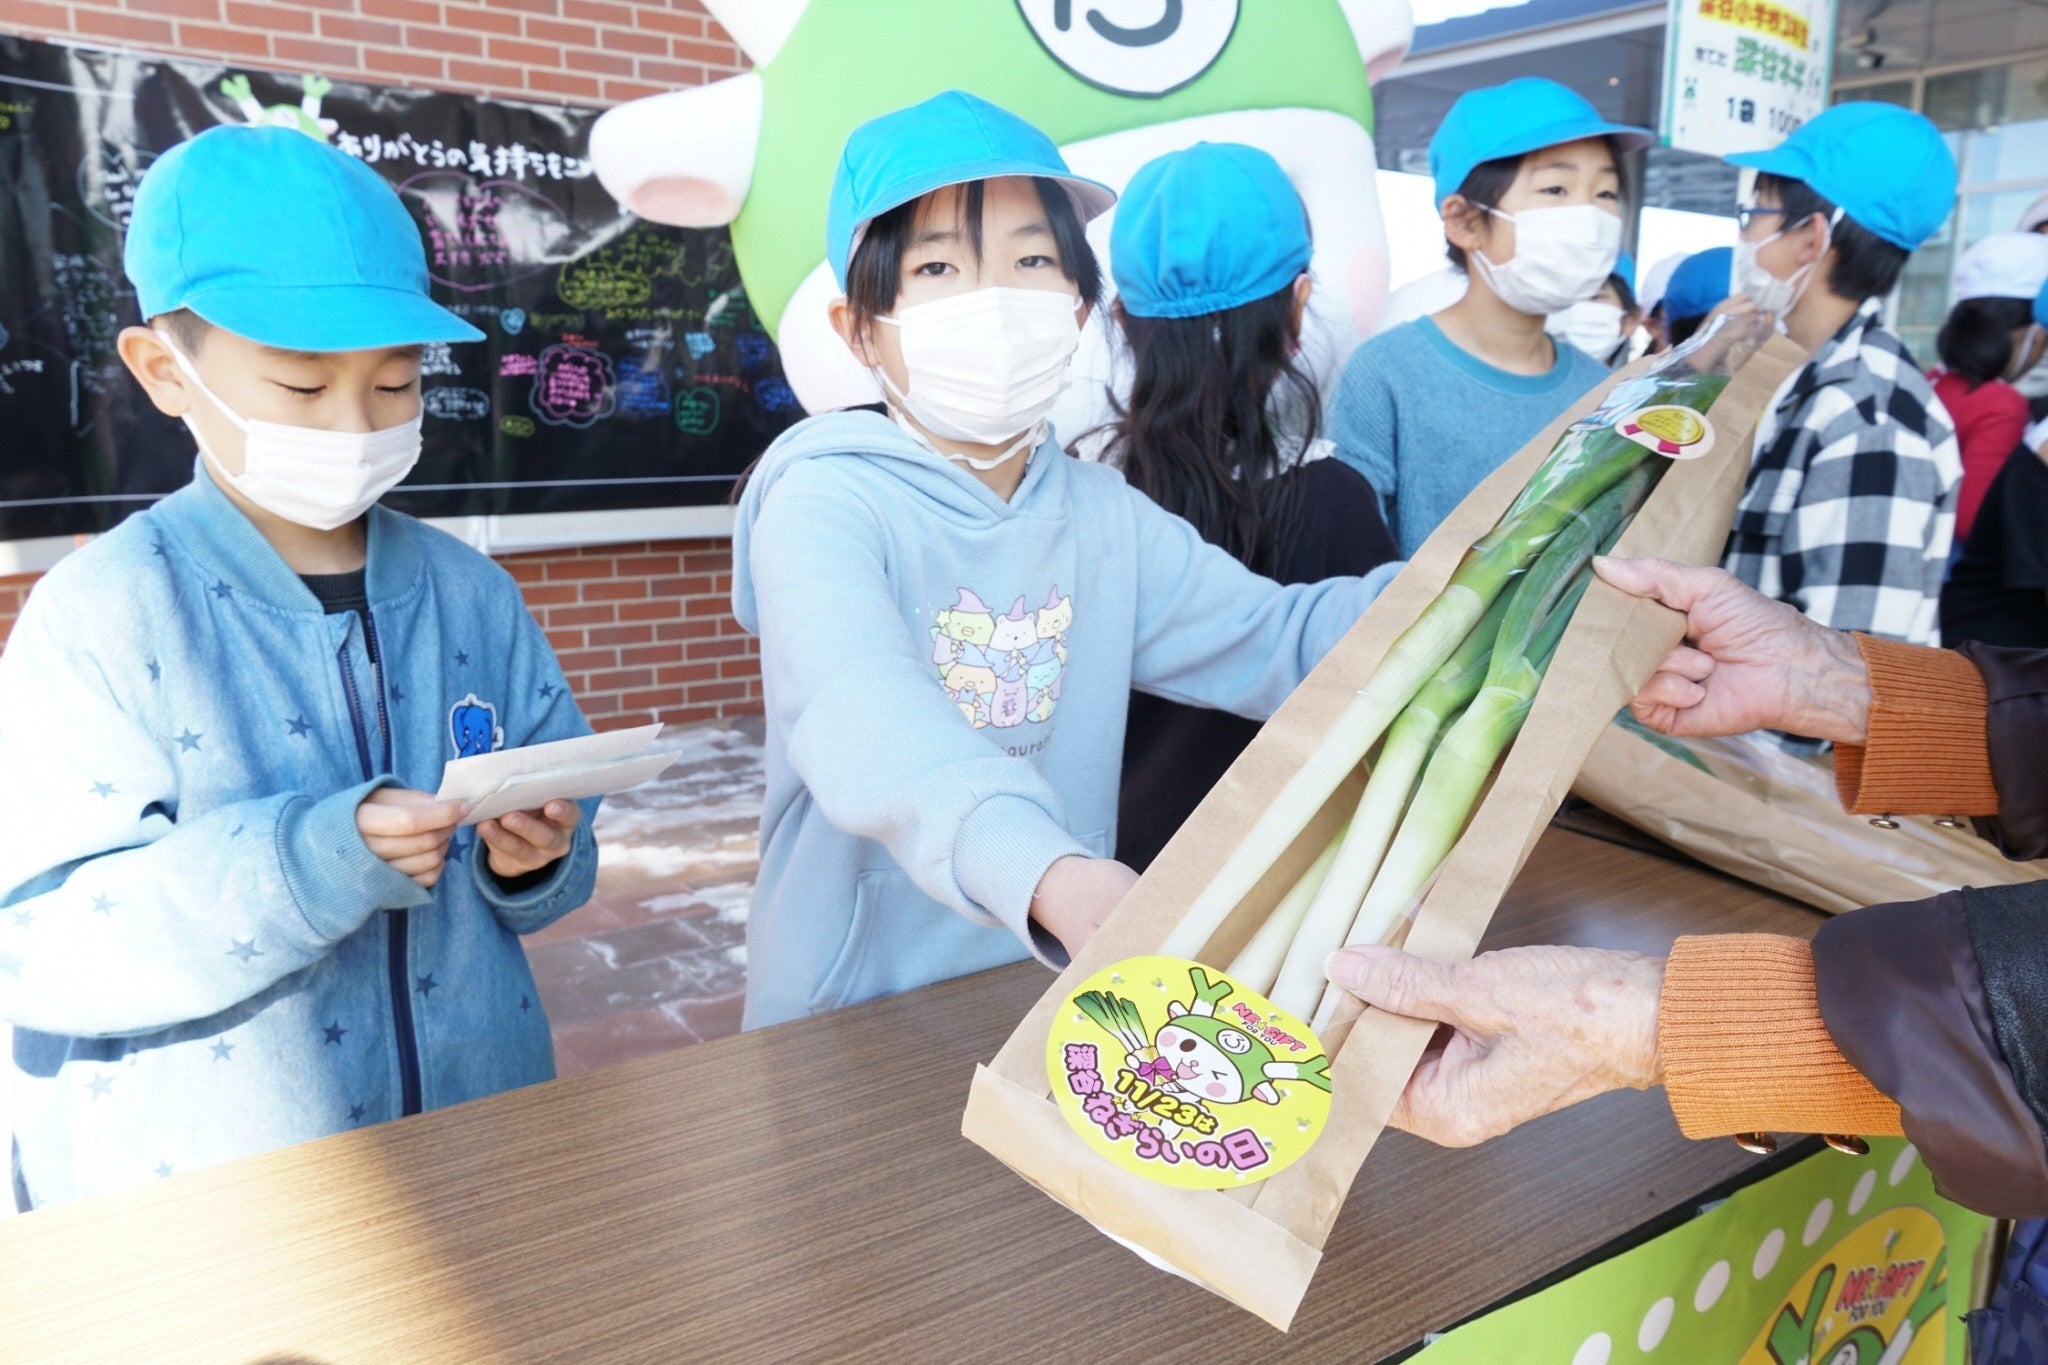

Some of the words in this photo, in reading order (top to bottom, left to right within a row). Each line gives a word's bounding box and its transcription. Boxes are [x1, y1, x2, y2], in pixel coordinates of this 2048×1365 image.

[1241, 1021, 1259, 1034] FOR
[1260, 1033, 1279, 1046] YOU
[1064, 1043, 1269, 1171] 深谷ねぎらいの日
[1114, 1069, 1218, 1135] 11/23は
